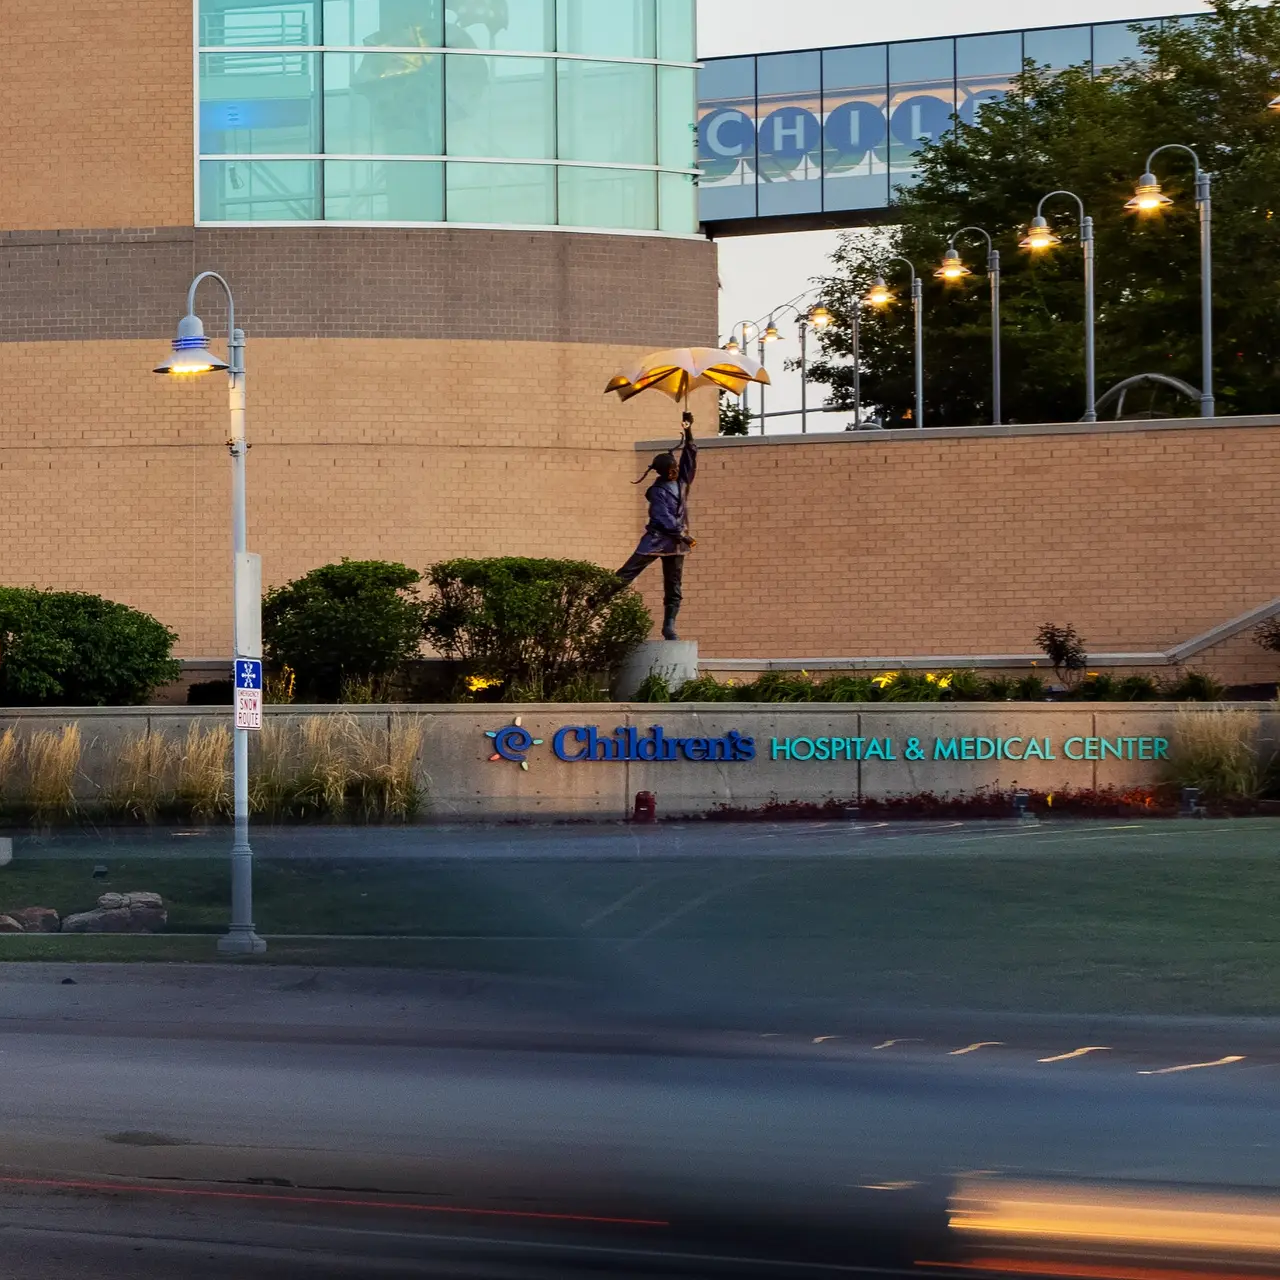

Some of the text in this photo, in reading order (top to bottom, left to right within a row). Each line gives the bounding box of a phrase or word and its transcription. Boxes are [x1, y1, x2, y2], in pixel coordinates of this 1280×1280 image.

[240, 698, 257, 710] SNOW
[238, 712, 258, 725] ROUTE
[552, 724, 1171, 762] Children's HOSPITAL & MEDICAL CENTER
